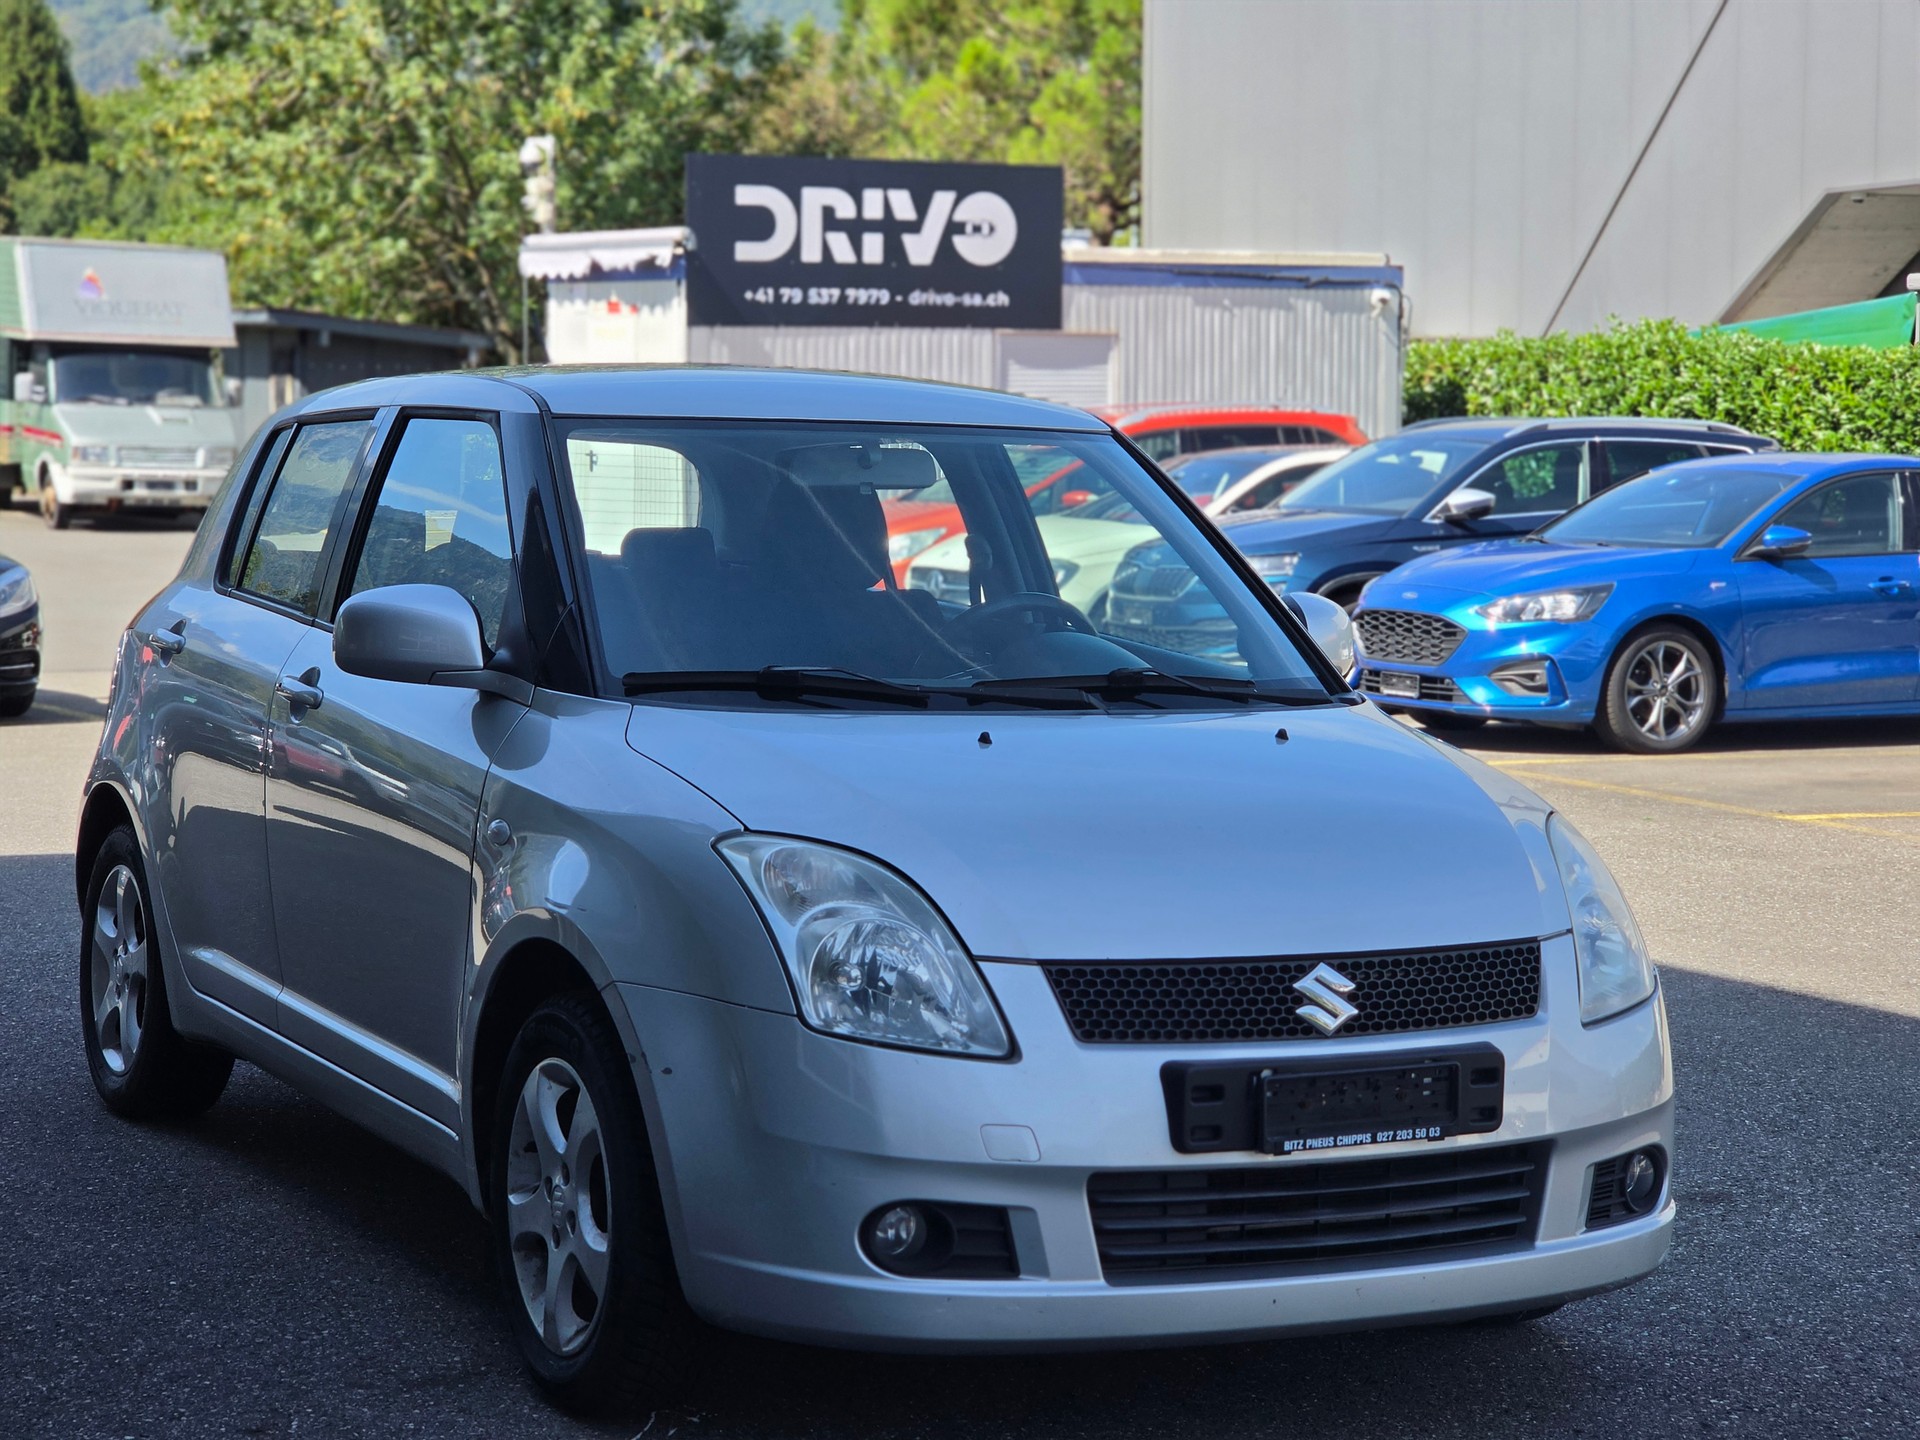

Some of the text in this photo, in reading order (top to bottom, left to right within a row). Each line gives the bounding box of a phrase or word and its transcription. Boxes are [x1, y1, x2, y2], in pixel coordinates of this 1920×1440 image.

[733, 184, 1018, 267] DRIVO
[743, 286, 775, 304] +41
[778, 286, 804, 305] 79
[807, 286, 842, 306] 537
[844, 287, 891, 306] 7979
[907, 288, 1010, 308] drivo-sa.ch
[1284, 1126, 1441, 1151] BITZ PNEUS CHIPPIS 027 203 50 03
